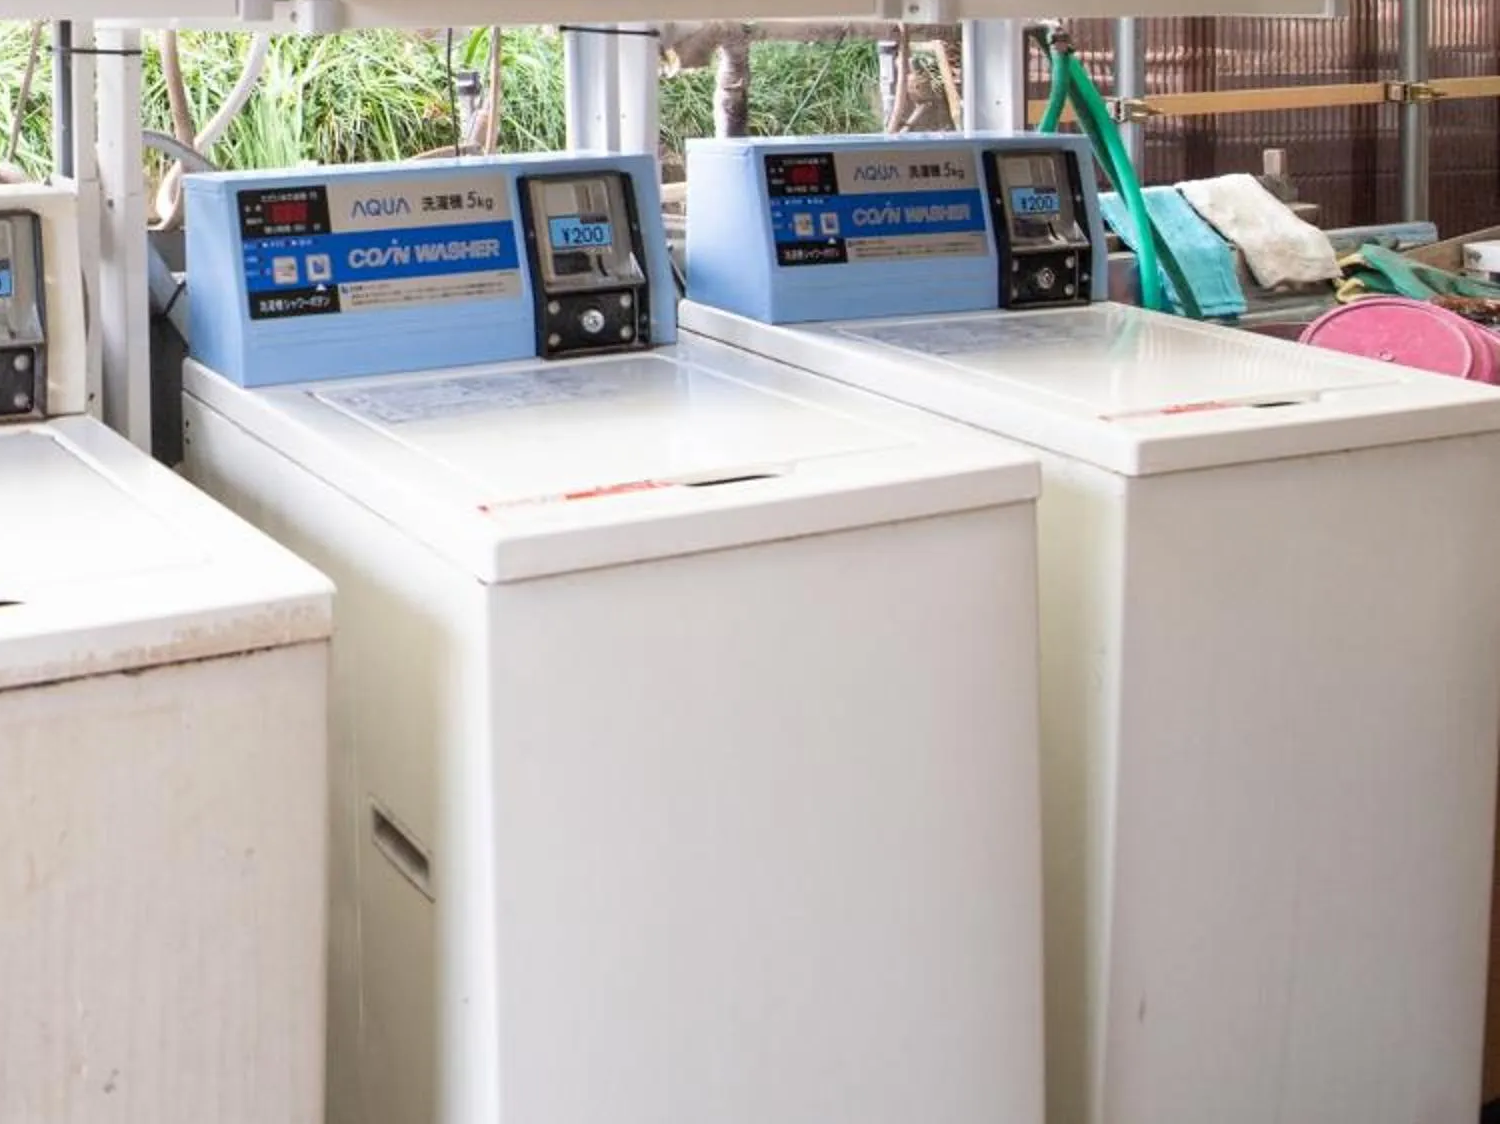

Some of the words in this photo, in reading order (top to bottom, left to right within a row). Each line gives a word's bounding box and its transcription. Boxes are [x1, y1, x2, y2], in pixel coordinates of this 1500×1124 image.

[852, 164, 899, 182] AQUA
[352, 196, 412, 218] AQUA
[421, 194, 465, 212] 洗濯機
[466, 191, 494, 211] 5kg
[561, 226, 604, 244] ¥200
[414, 238, 501, 264] WASHER
